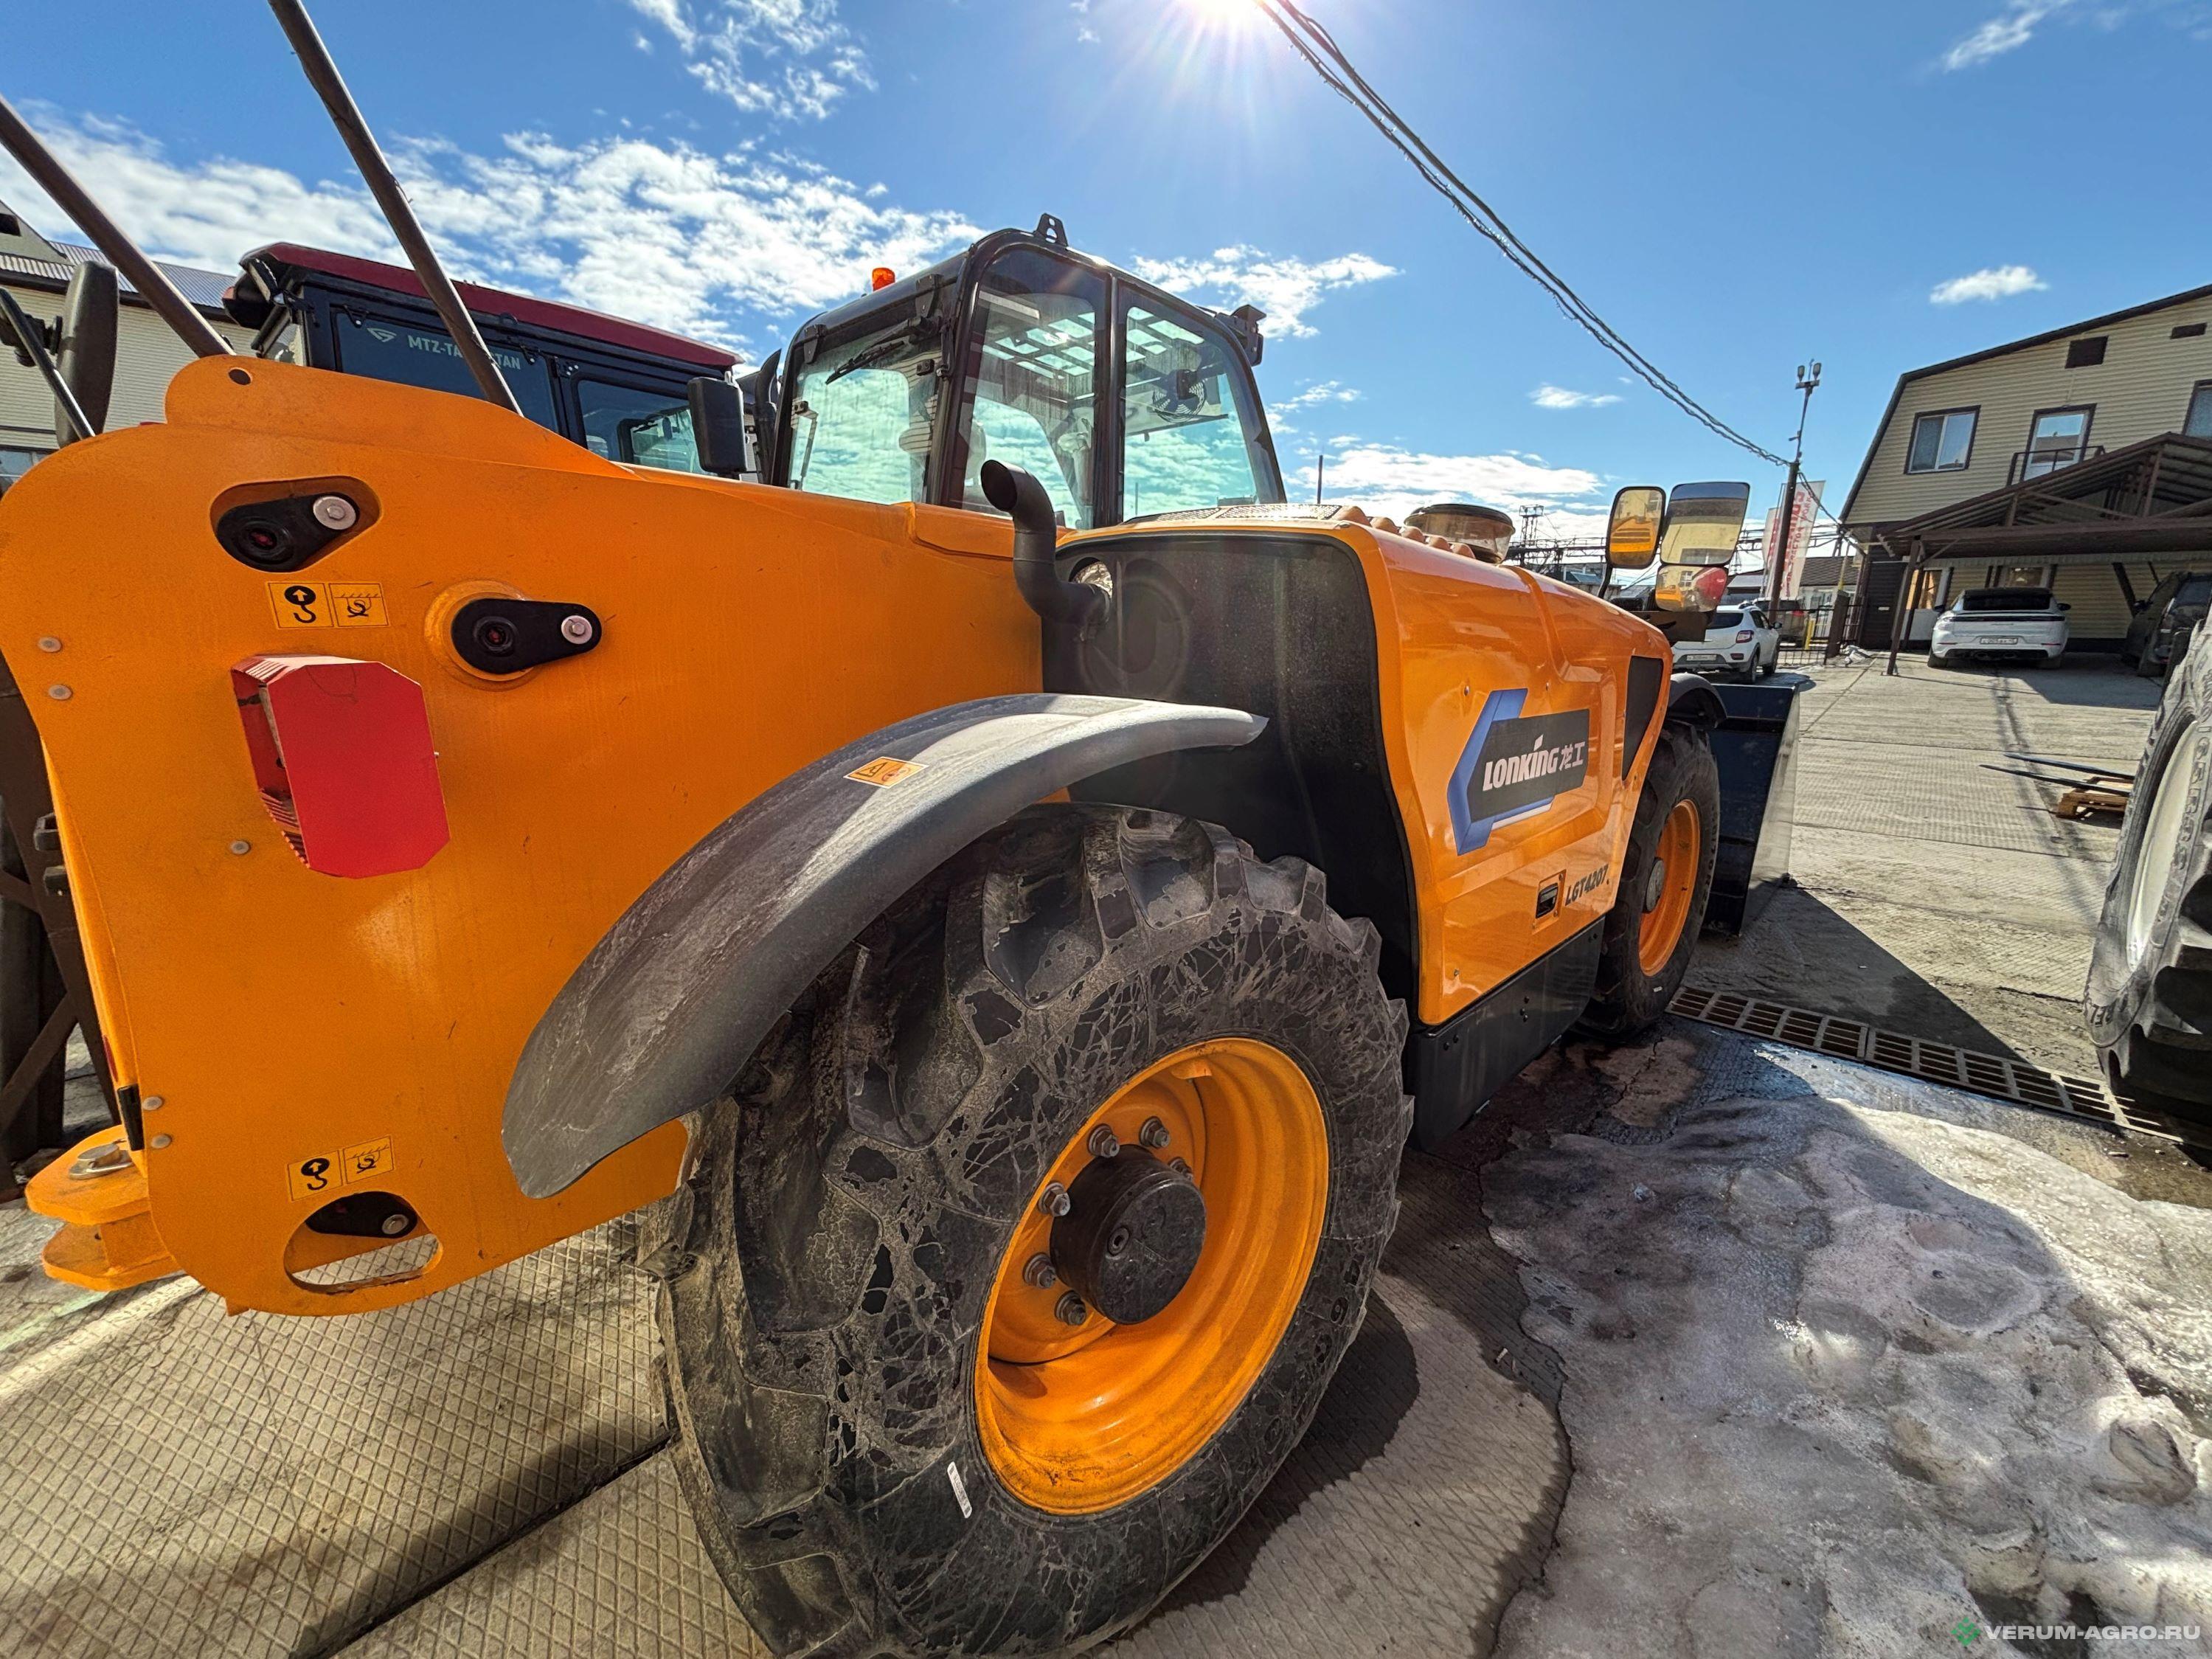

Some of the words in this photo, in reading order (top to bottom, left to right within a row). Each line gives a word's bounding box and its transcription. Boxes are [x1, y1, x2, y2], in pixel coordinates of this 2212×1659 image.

[408, 335, 521, 370] MTZ-TATAN
[1559, 741, 1586, 772] 龙工
[1565, 863, 1609, 907] LGT4207
